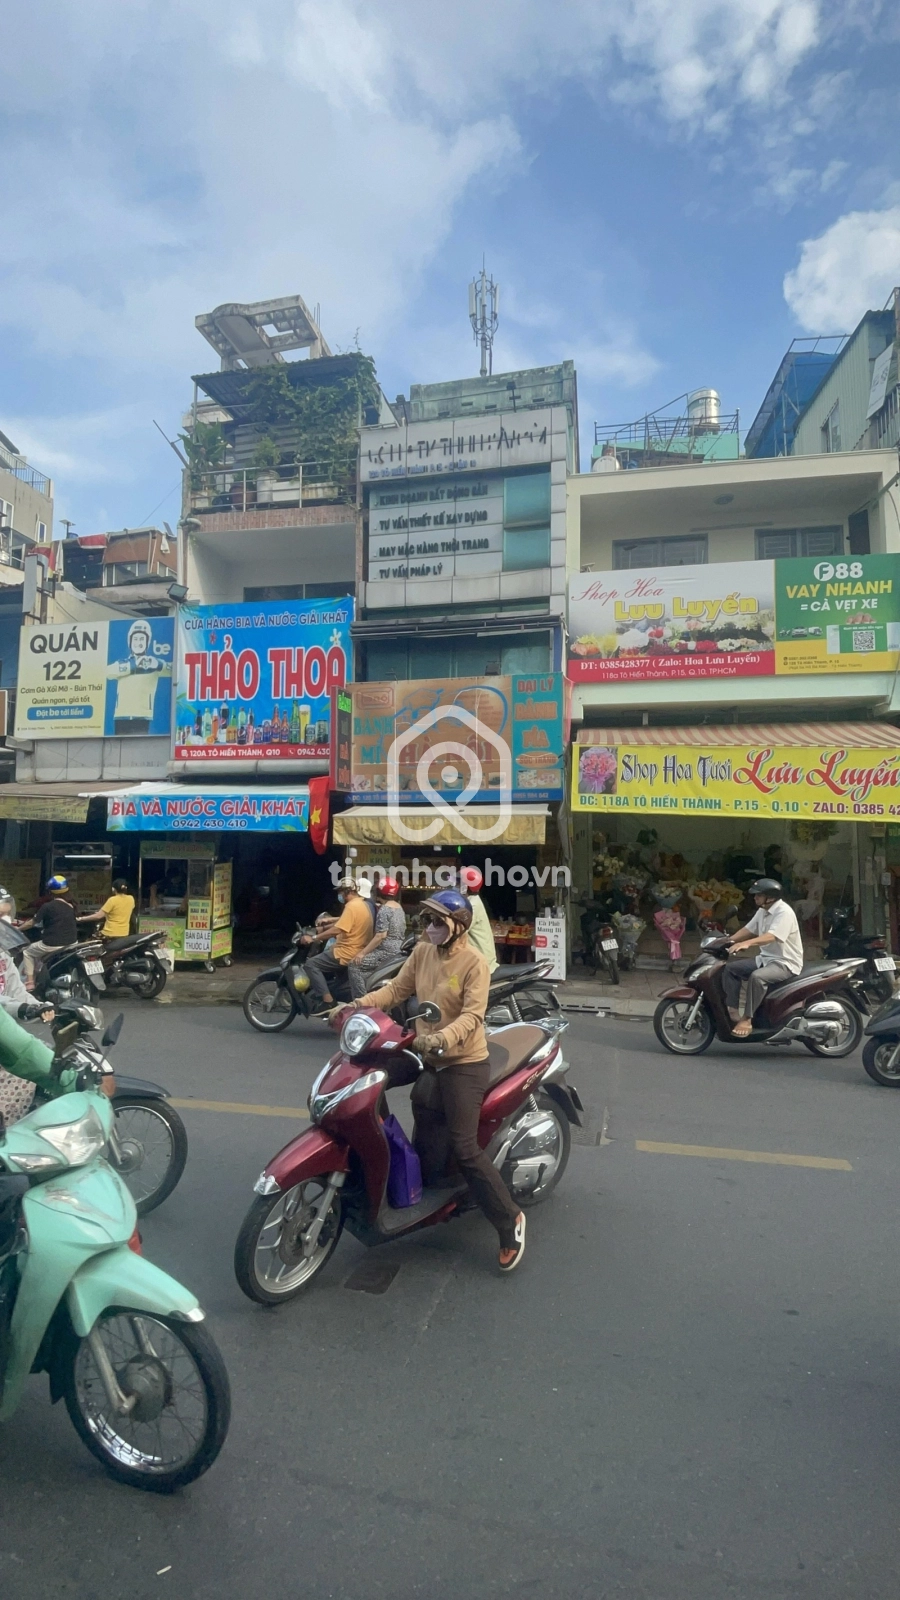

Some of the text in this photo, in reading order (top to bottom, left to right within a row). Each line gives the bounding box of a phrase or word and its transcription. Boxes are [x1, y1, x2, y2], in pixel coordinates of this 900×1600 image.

[379, 546, 396, 557] MAY
[462, 538, 489, 550] TRANG
[410, 563, 431, 577] PHÁP
[571, 576, 665, 606] Shop Hoa
[786, 580, 892, 599] VAY NHANH
[613, 592, 760, 623] Lưu Luyến
[810, 598, 831, 611] CÀ
[835, 599, 858, 613] VẸT
[861, 598, 878, 609] XE
[184, 608, 348, 631] CỬA HÀNG BIA VÀ NƯỚC GIẢI KHÁT
[30, 626, 99, 654] QUÁN
[153, 640, 171, 655] be
[43, 659, 82, 682] 122
[184, 634, 260, 701] THẢO
[580, 661, 597, 670] ĐT:
[599, 659, 650, 669] 0385428377
[658, 657, 682, 667] Zalo:
[684, 657, 703, 666] Hoa
[705, 655, 725, 666] Lưu
[620, 671, 628, 679] Tô
[629, 668, 645, 679] Hiến
[20, 687, 35, 695] Cơm
[36, 685, 46, 694] Gà
[87, 683, 103, 692] Thái
[32, 697, 49, 705] Quán
[69, 696, 80, 704] giá
[80, 695, 90, 703] tốt
[49, 708, 60, 717] be
[190, 749, 206, 758] 120A
[208, 747, 218, 757] TÔ
[219, 747, 236, 757] HIẾN
[237, 747, 265, 758] THÀNH,
[266, 748, 280, 757] Q10
[297, 748, 315, 756] 0942
[620, 754, 659, 786] Shop
[662, 754, 692, 787] Hoa
[697, 755, 732, 787] Tươi
[733, 748, 804, 794] Lưu
[111, 795, 306, 816] BIA VÀ NƯỚC GIẢI KHÁT
[580, 795, 598, 805] ĐC:
[602, 796, 630, 806] 118A
[633, 795, 647, 807] TÔ
[651, 794, 678, 808] HIẾN
[681, 796, 722, 809] THÀNH
[734, 800, 759, 811] P.15
[772, 801, 799, 812] Q.10
[813, 802, 849, 814] ZALO:
[853, 803, 885, 815] 0385
[172, 819, 247, 828] 0942 430 410
